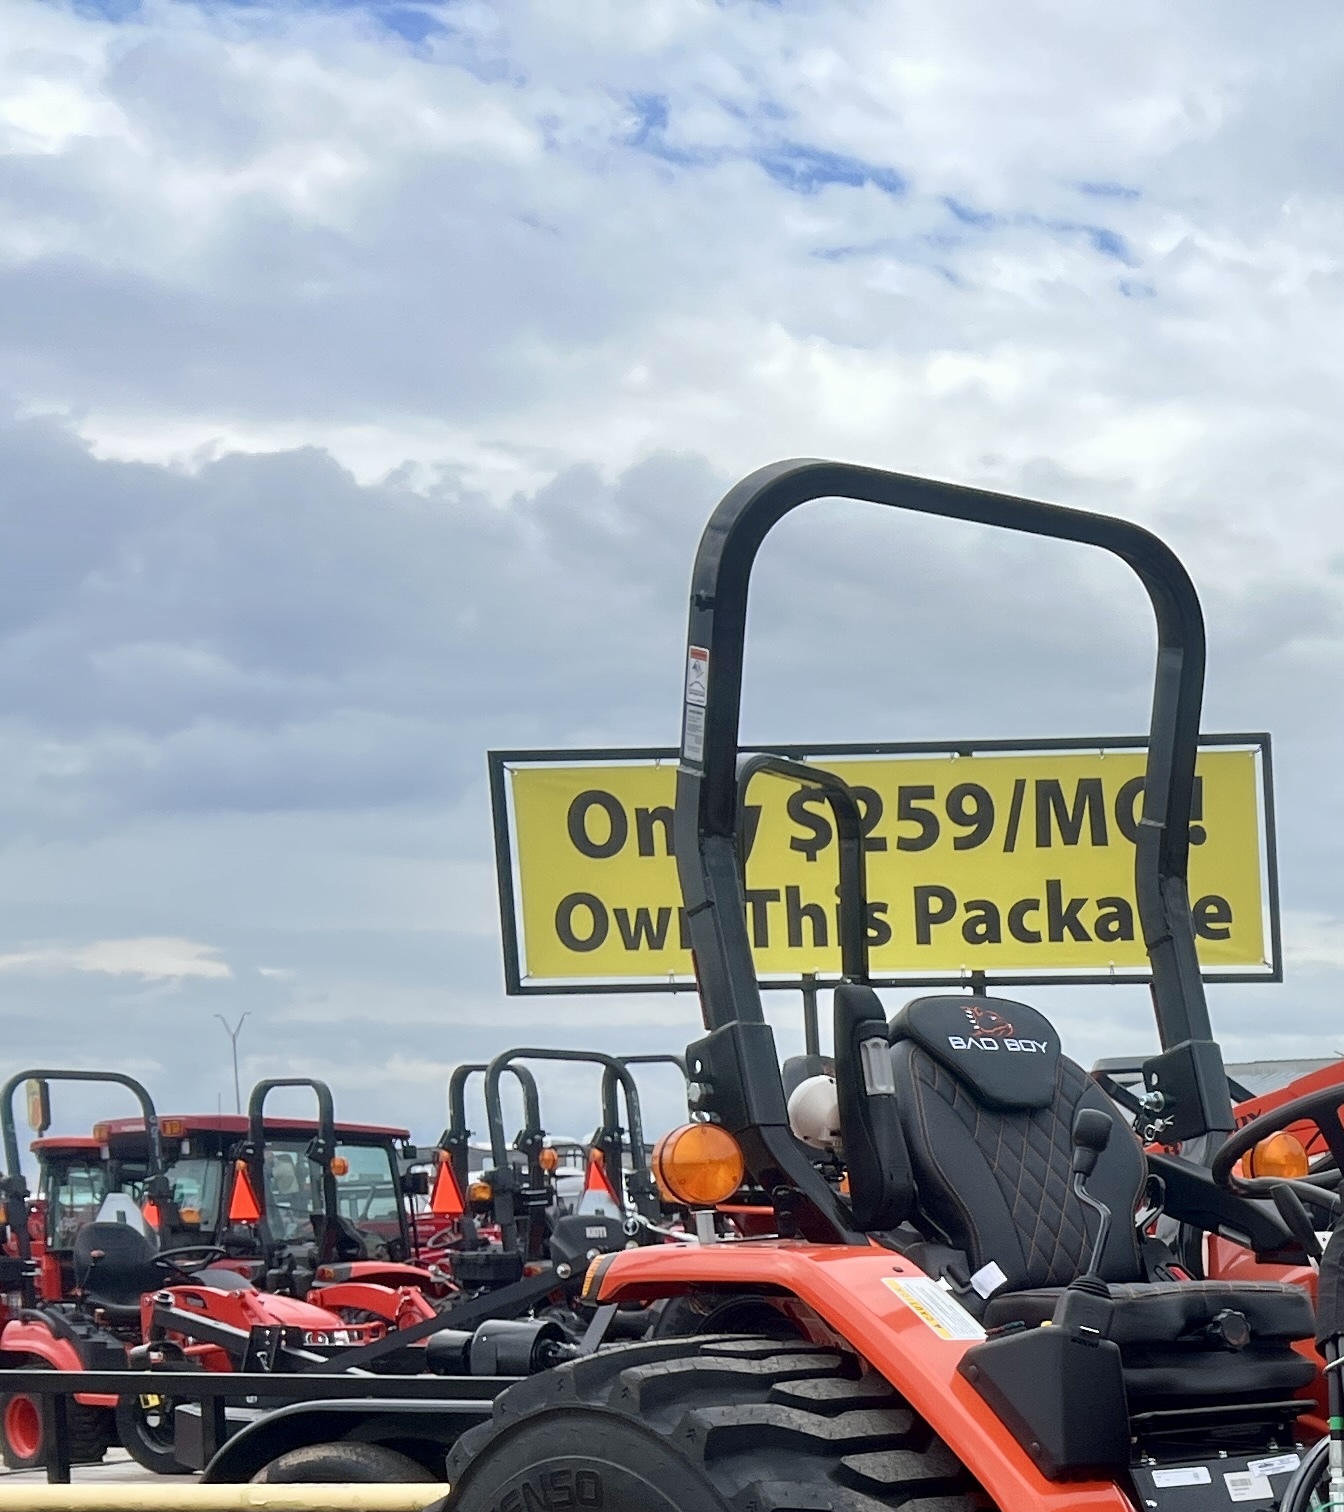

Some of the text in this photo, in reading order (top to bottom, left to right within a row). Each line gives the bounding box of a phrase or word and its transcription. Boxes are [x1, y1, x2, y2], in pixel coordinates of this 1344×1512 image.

[913, 878, 1234, 945] Packae
[948, 1036, 1048, 1054] BAD BOY
